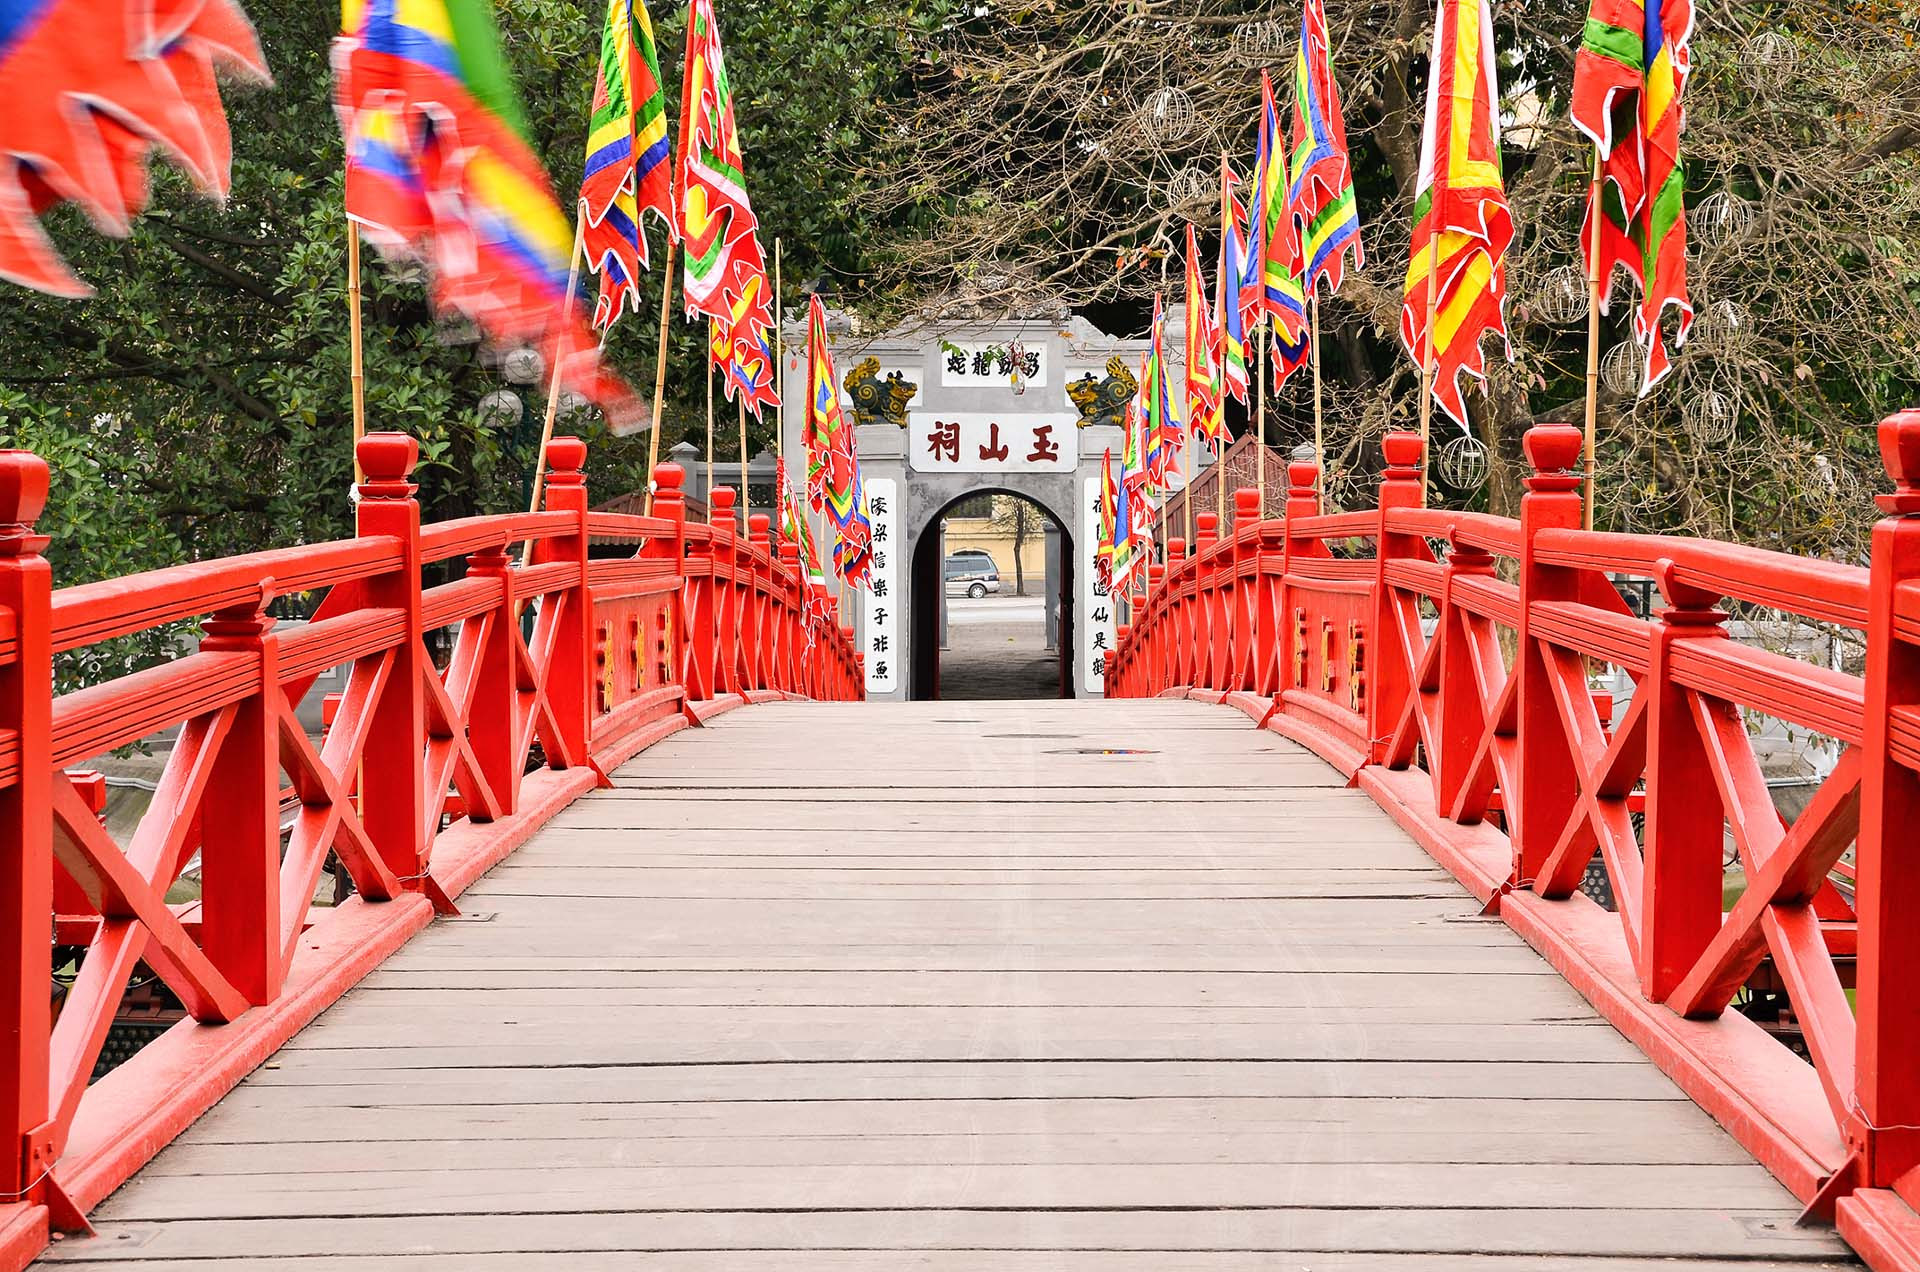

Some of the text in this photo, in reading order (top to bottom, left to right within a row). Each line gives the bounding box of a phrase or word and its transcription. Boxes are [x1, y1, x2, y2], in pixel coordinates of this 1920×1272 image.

[927, 421, 1059, 463] 玉山祠
[1092, 494, 1109, 677] 過仙是鶴
